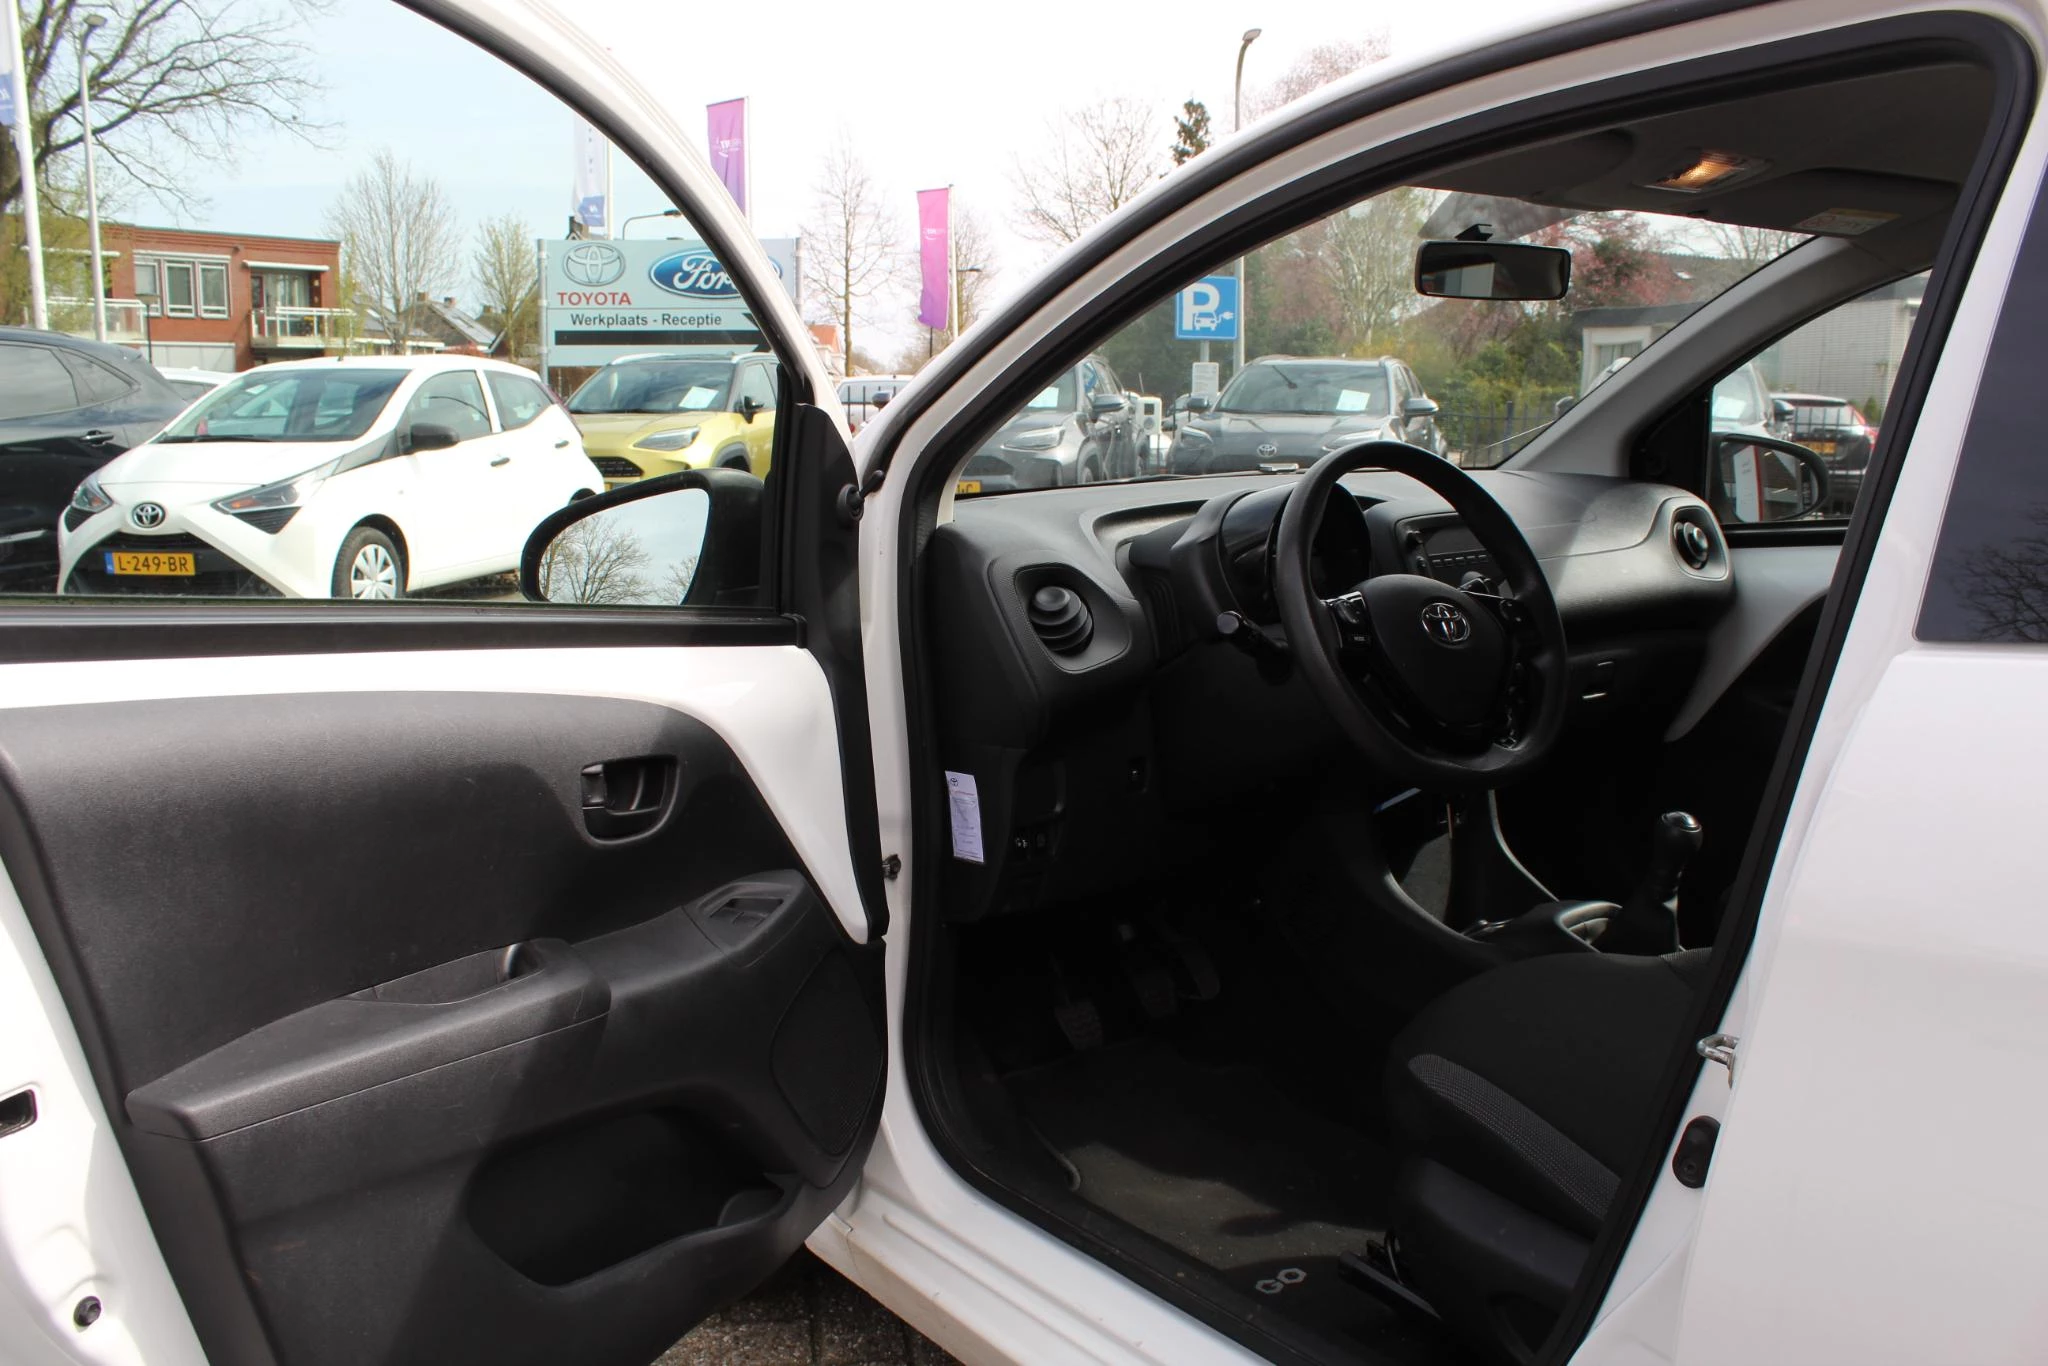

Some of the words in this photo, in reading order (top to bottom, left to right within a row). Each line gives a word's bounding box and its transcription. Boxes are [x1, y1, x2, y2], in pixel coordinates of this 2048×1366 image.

[673, 255, 738, 290] For
[557, 292, 632, 306] TOYOTA
[1182, 282, 1220, 331] P
[571, 313, 648, 328] Werkplaats
[661, 312, 722, 328] Receptie
[117, 555, 189, 572] L-249-BR
